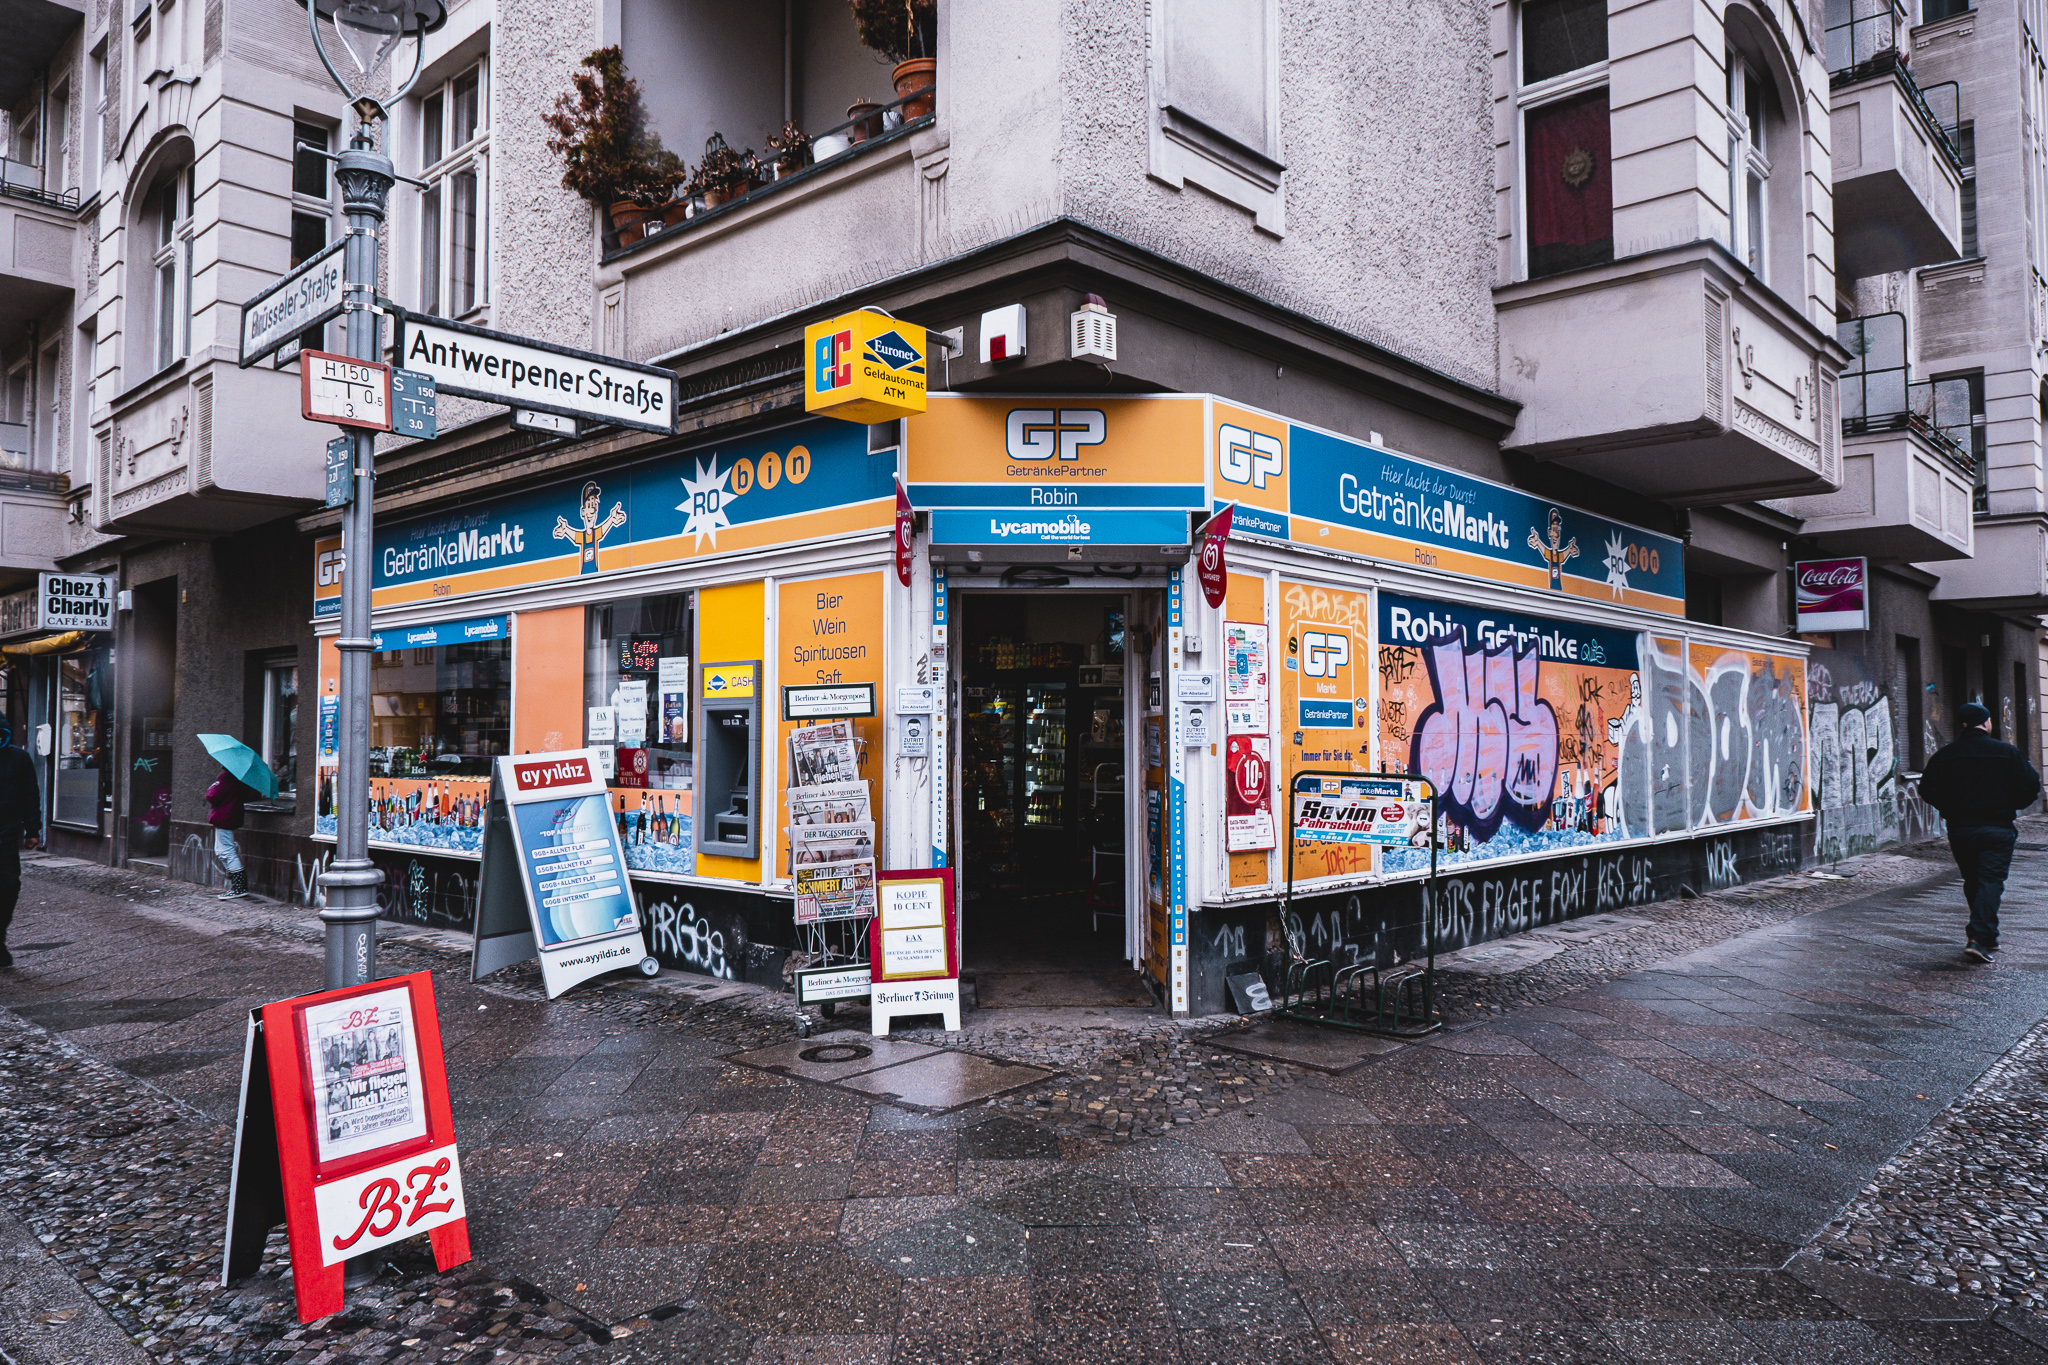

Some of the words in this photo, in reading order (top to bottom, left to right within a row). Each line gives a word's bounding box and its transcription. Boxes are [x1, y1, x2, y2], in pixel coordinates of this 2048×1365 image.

[251, 290, 299, 340] Brüsseler
[300, 264, 338, 310] Straße
[874, 339, 915, 361] Euronet
[409, 329, 584, 395] Antwerpener
[588, 368, 664, 414] Straße
[863, 366, 925, 390] Geldautomat
[393, 376, 405, 392] S
[418, 386, 435, 398] 150
[883, 386, 906, 400] ATM
[528, 413, 535, 423] 7
[554, 418, 559, 428] 1
[1006, 408, 1107, 461] GP
[326, 450, 333, 465] S
[1218, 423, 1283, 490] GP
[1006, 465, 1107, 478] GetränkePartner
[1381, 464, 1404, 485] Hier
[1404, 467, 1431, 493] lacht
[1432, 475, 1448, 497] der
[1449, 483, 1477, 505] Durst!
[693, 489, 720, 516] RO
[1031, 488, 1079, 506] Robin
[1339, 473, 1510, 550] GetränkeMarkt
[990, 515, 1091, 537] Lycamobile
[1231, 515, 1282, 533] tränkePartner
[383, 522, 525, 578] GetränkeMarkt
[1414, 547, 1438, 567] Robin
[1800, 566, 1861, 587] Coca-Cola
[48, 577, 94, 597] Chez
[432, 582, 451, 597] Robin
[48, 597, 110, 618] Charly
[816, 593, 843, 610] Bier
[464, 619, 499, 638] Lycamobile
[813, 617, 846, 635] Wein
[407, 627, 438, 644] Lycamobile
[793, 644, 867, 666] Spirituosen
[1302, 631, 1349, 679] GP
[731, 676, 754, 688] CASH
[816, 669, 843, 685] Saft
[1316, 682, 1337, 694] Markt
[795, 694, 820, 702] Berliner
[829, 692, 866, 701] Morgenpost
[1304, 708, 1349, 720] GetränkePartner
[1301, 750, 1322, 762] Immer
[1322, 749, 1333, 762] für
[1333, 749, 1343, 761] Sie
[619, 777, 642, 786] WULLE
[1244, 759, 1259, 789] 10
[796, 792, 819, 800] Berliner
[828, 788, 863, 797] Morgenpost
[1322, 781, 1340, 792] GP
[1300, 800, 1378, 822] Sevim
[1298, 818, 1373, 832] Fahrschule
[579, 859, 593, 867] FLAT
[797, 878, 841, 895] SCHMIERT
[841, 877, 854, 891] AB
[896, 890, 928, 899] KOPIE
[561, 892, 590, 903] INTERNET
[893, 903, 903, 911] 10
[905, 901, 933, 911] CENT
[799, 898, 817, 916] Bild
[905, 934, 923, 942] FAX
[559, 945, 631, 969] www.ayyildiz.de
[807, 978, 833, 987] Berliner
[842, 974, 871, 985] Morgenp
[876, 990, 914, 1004] Berliner
[921, 991, 955, 1003] Zeitung
[347, 1078, 368, 1096] Wir
[368, 1071, 407, 1092] fliegen
[351, 1090, 379, 1110] nach
[378, 1084, 409, 1103] Malle
[364, 1109, 397, 1123] Doppelmord
[361, 1120, 379, 1131] Jahren
